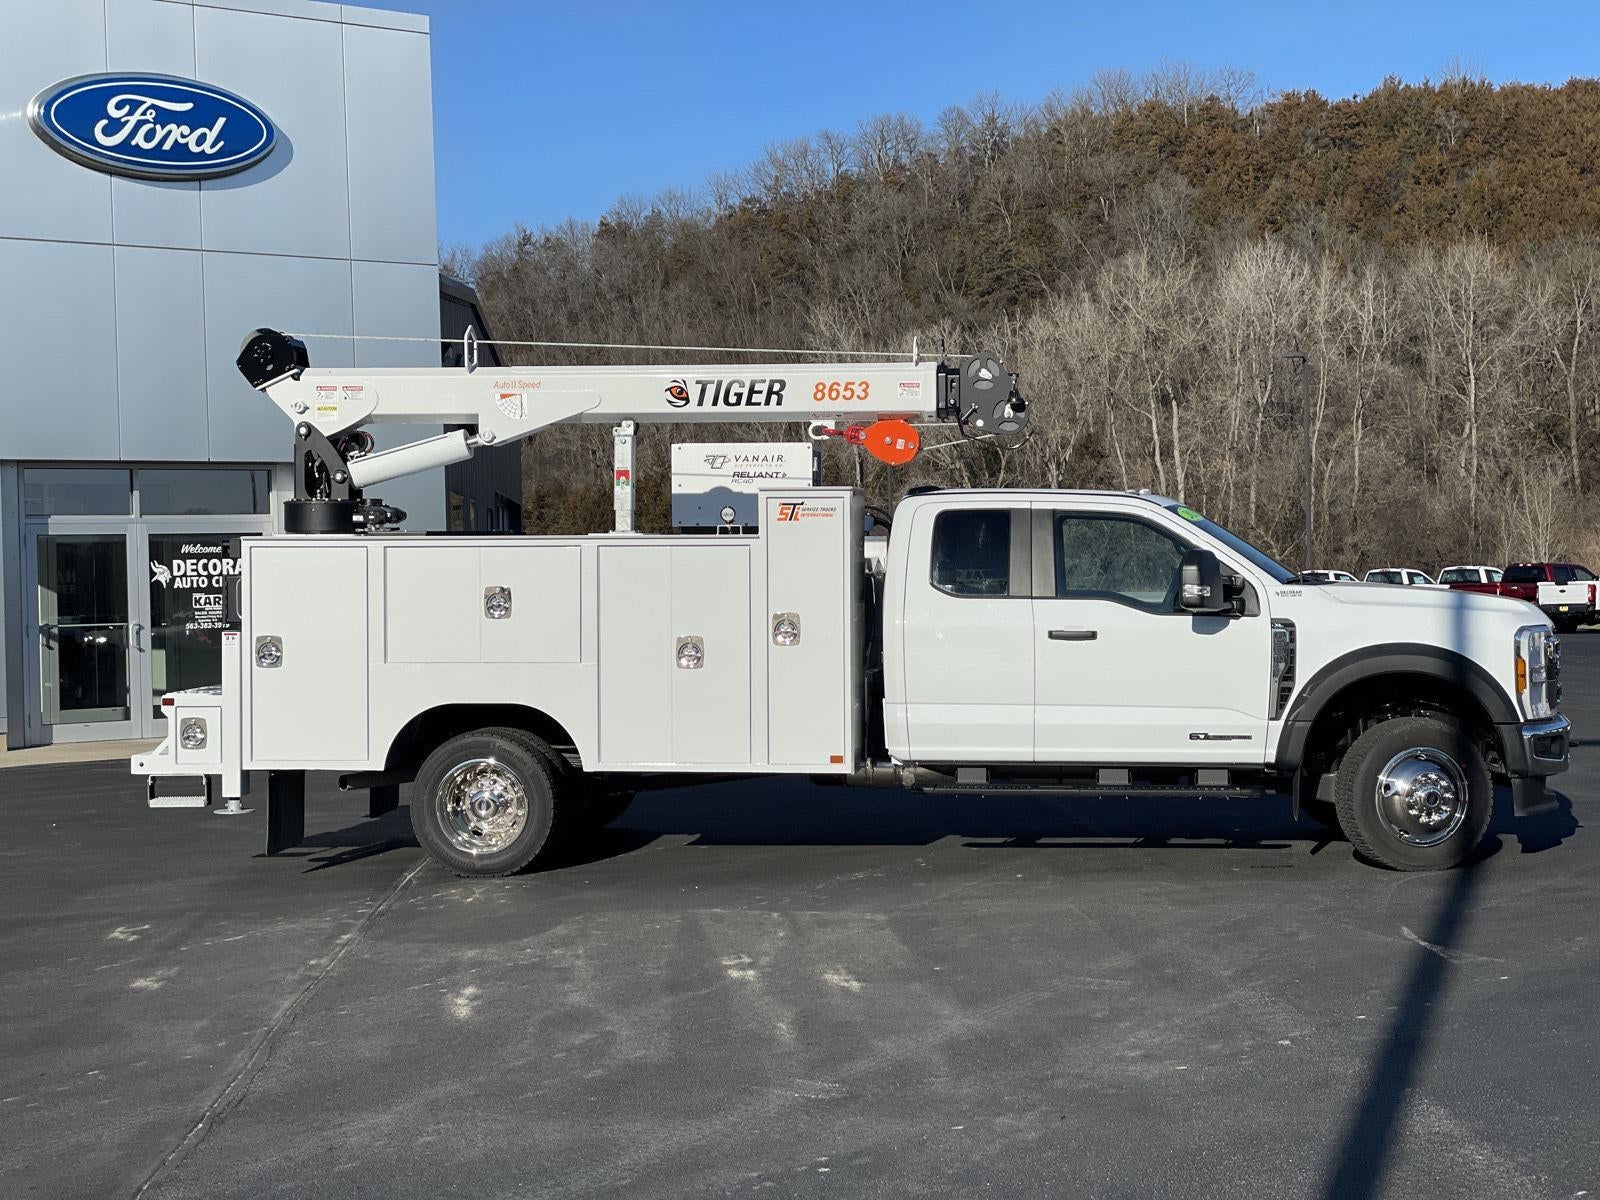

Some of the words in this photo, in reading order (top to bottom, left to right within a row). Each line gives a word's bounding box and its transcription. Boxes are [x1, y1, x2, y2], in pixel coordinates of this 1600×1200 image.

[94, 94, 227, 154] Ford
[694, 378, 787, 407] TIGER
[813, 380, 870, 401] 8653
[734, 454, 784, 463] VANAIR
[181, 543, 222, 554] Welcome
[173, 576, 208, 588] AUTO
